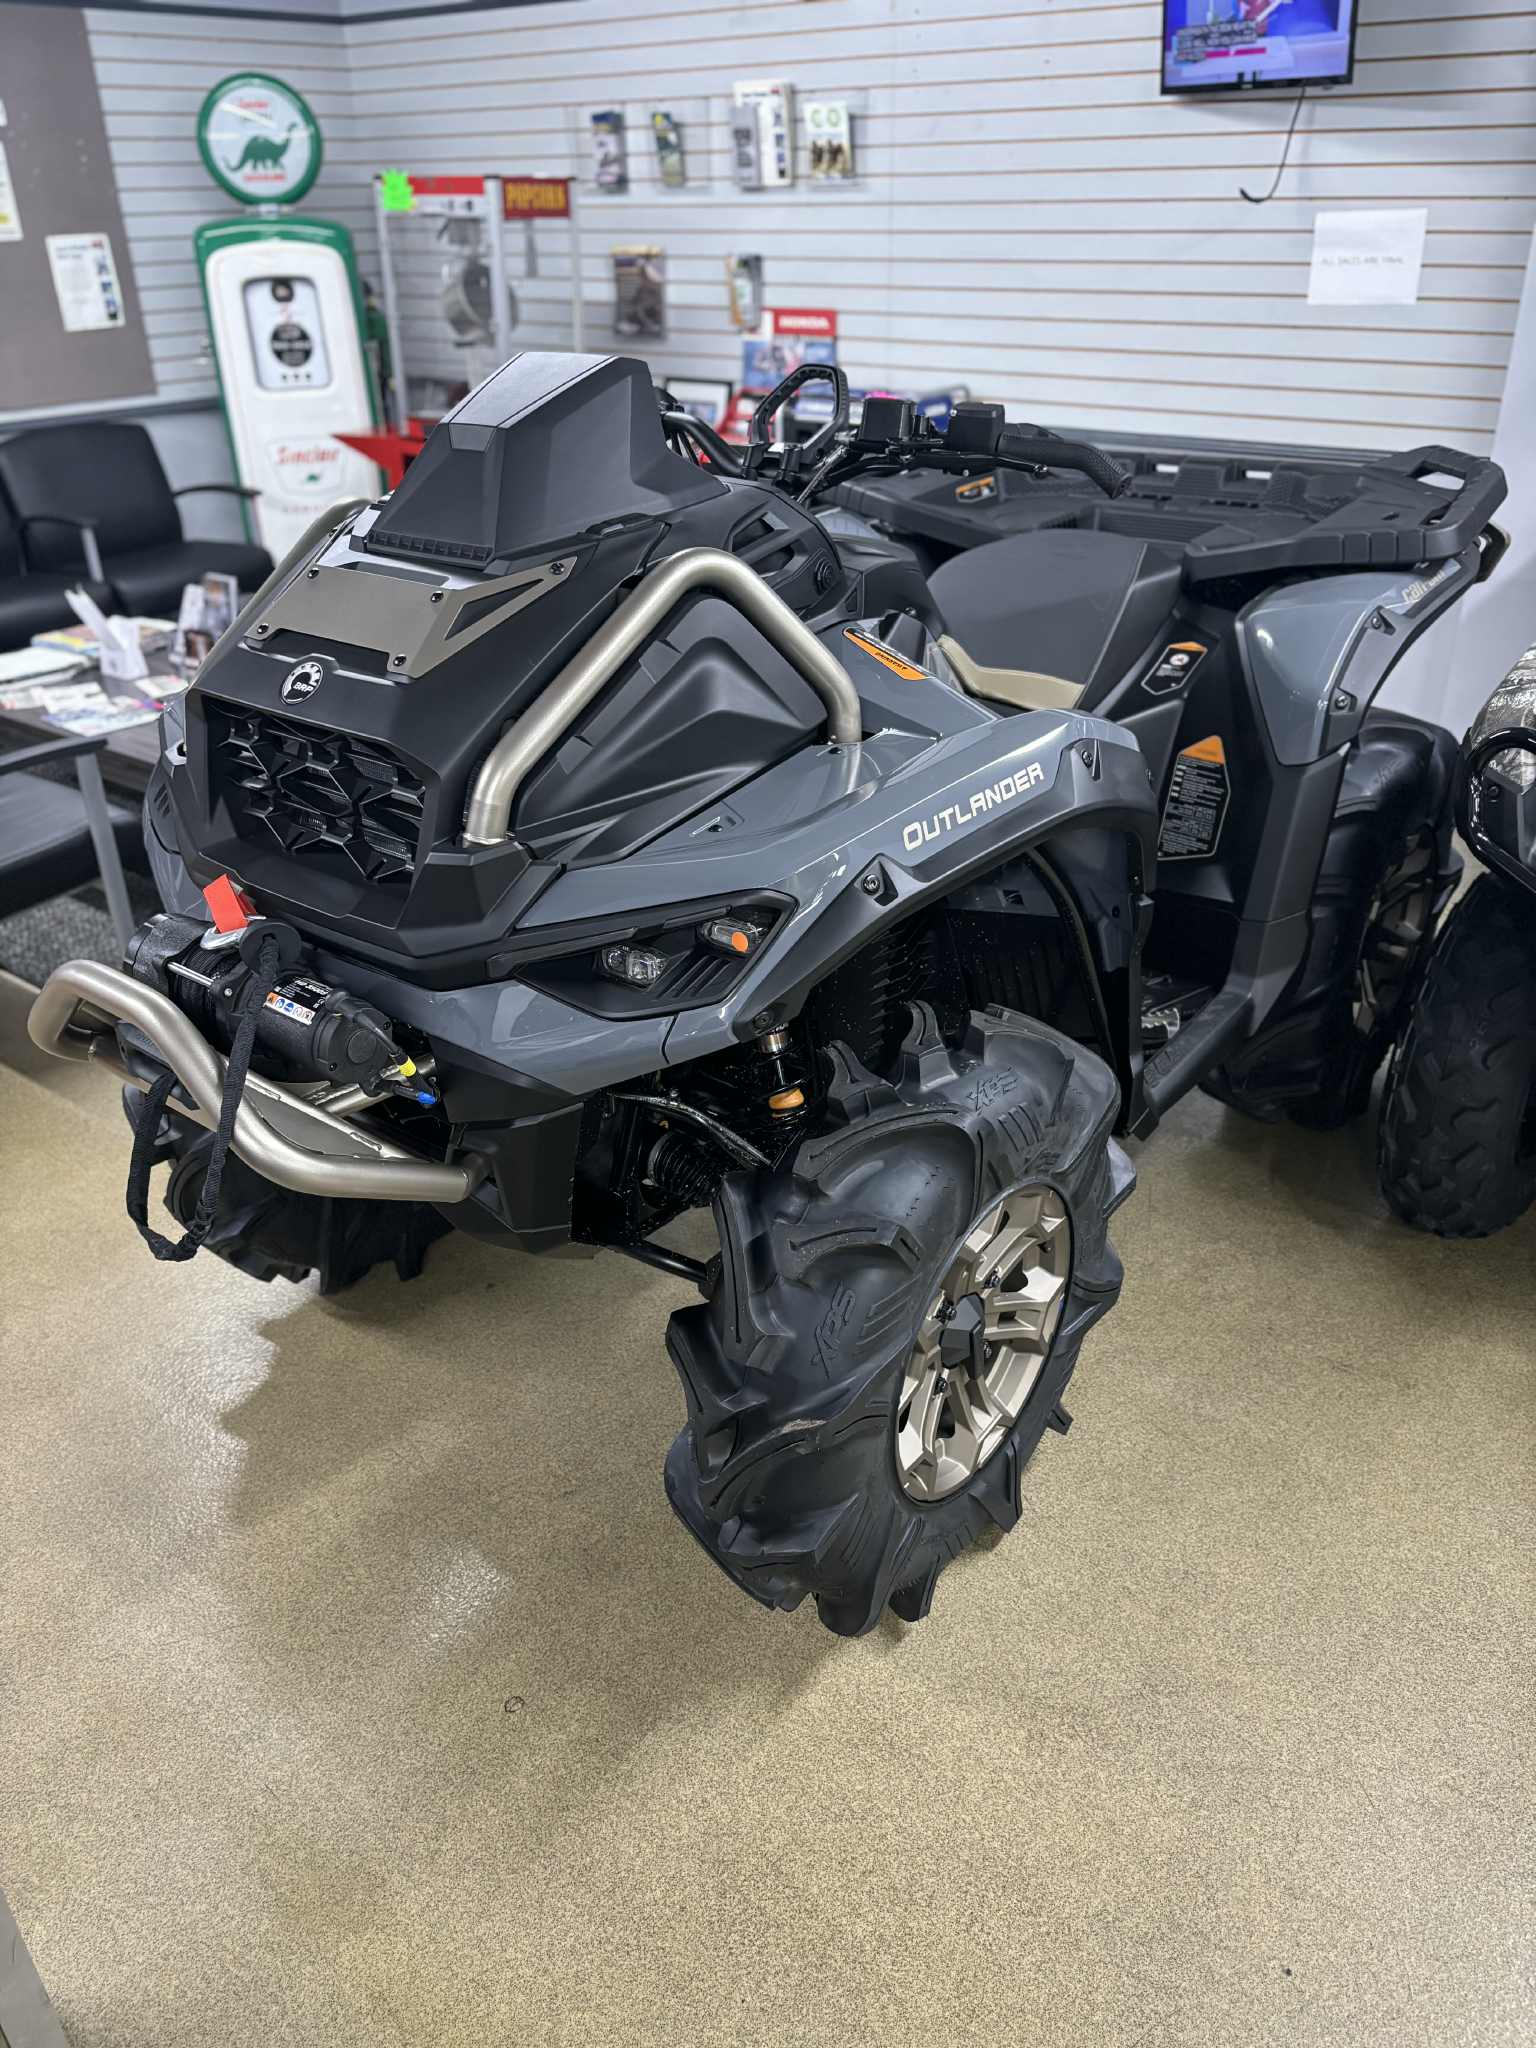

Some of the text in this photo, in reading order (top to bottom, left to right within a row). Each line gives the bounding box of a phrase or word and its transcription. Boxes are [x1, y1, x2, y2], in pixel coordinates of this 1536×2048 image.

[506, 182, 567, 210] POPCORN
[778, 315, 830, 330] HONDA
[293, 682, 314, 692] BRP
[902, 761, 1045, 851] OUTLANDER
[810, 1279, 857, 1380] XPS
